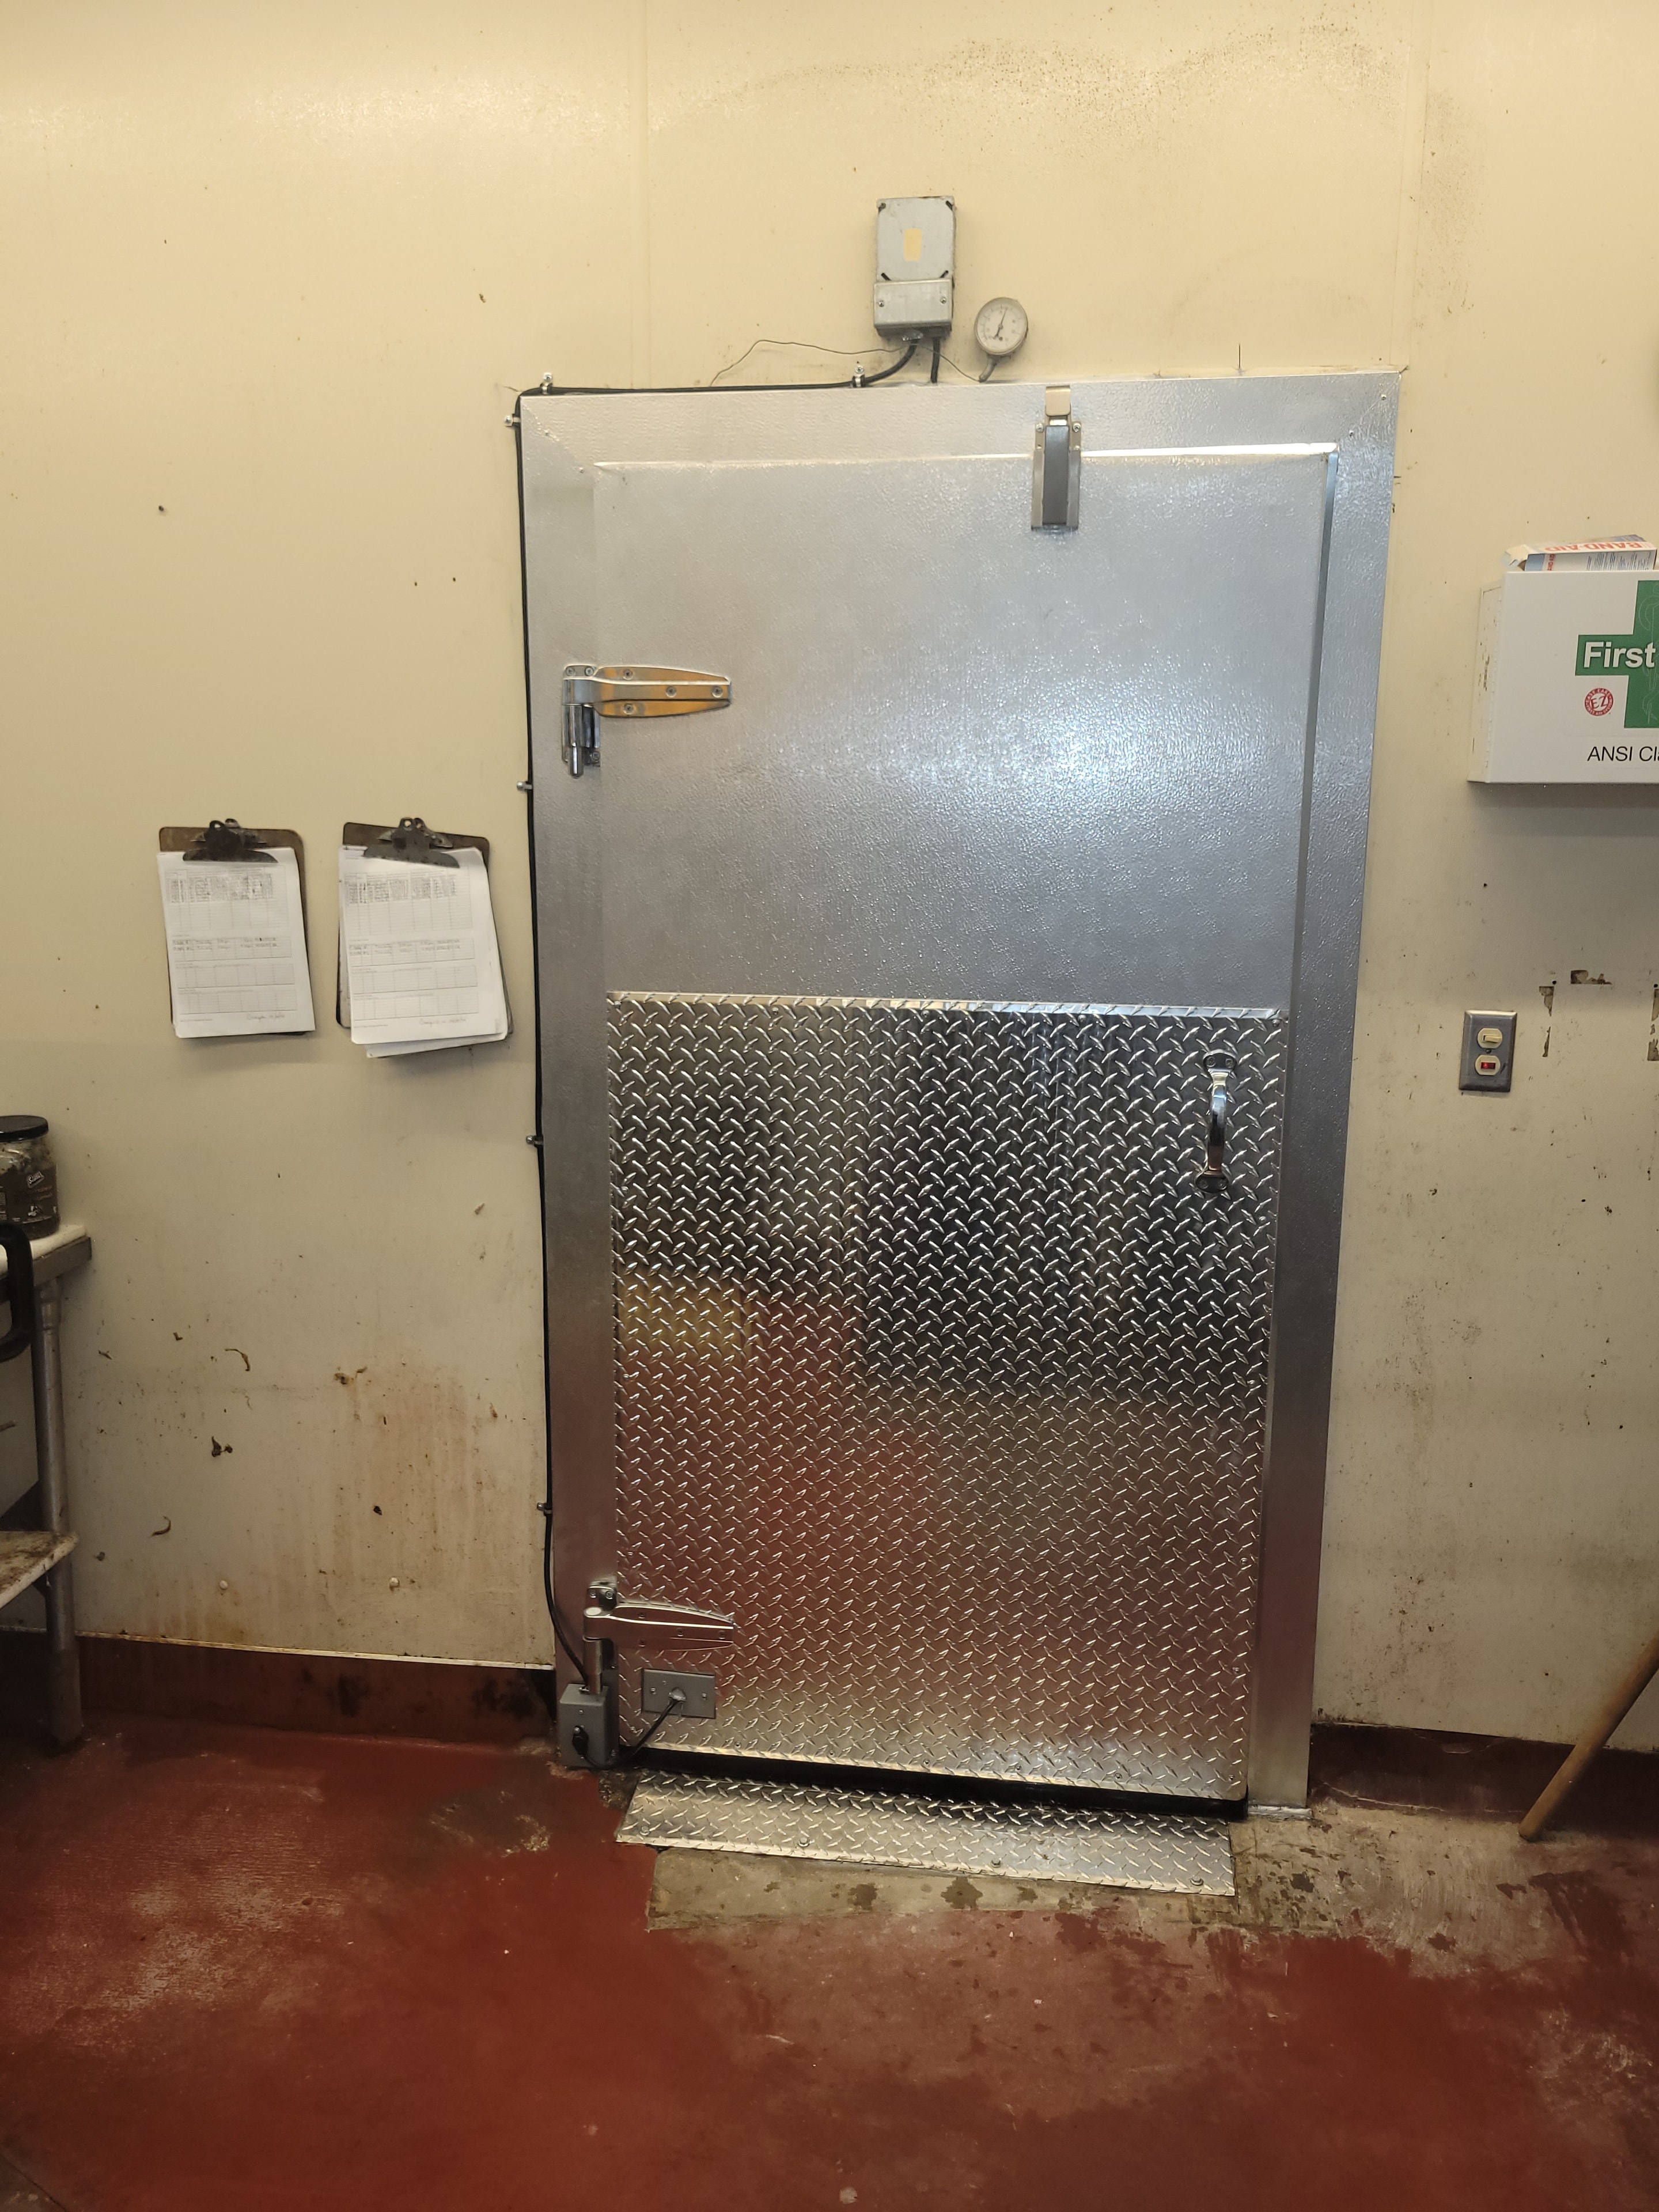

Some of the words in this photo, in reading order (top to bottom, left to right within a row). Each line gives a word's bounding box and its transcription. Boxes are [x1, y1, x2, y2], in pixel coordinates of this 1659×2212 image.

[1545, 542, 1642, 551] BAND-AID
[1584, 641, 1656, 668] First
[1590, 694, 1608, 710] EZ
[1587, 746, 1633, 762] ANSI
[1639, 745, 1659, 762] Cl
